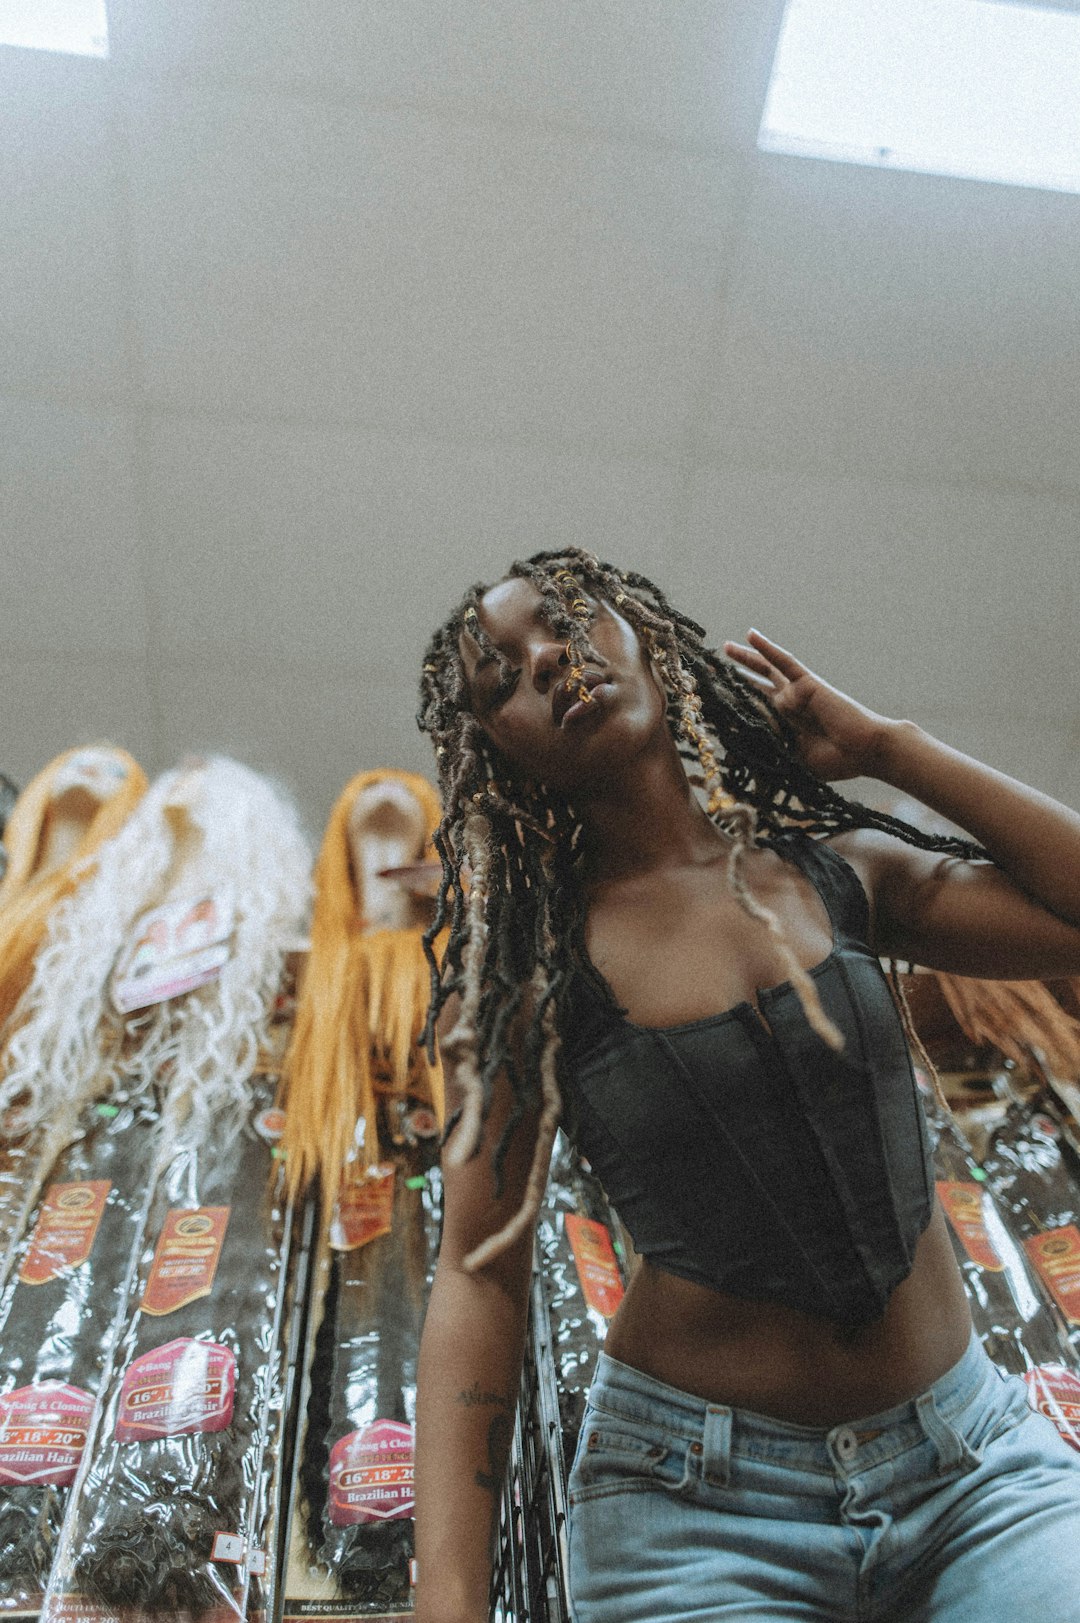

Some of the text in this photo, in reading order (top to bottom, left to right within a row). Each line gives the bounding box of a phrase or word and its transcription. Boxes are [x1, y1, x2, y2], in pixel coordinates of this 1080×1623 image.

[39, 1401, 48, 1410] &
[50, 1401, 91, 1413] Closure
[380, 1439, 388, 1449] &
[46, 1452, 75, 1464] Hair
[347, 1489, 398, 1502] Brazilian
[226, 1541, 232, 1550] 4
[300, 1604, 321, 1612] BEST
[322, 1603, 356, 1612] QUALITY
